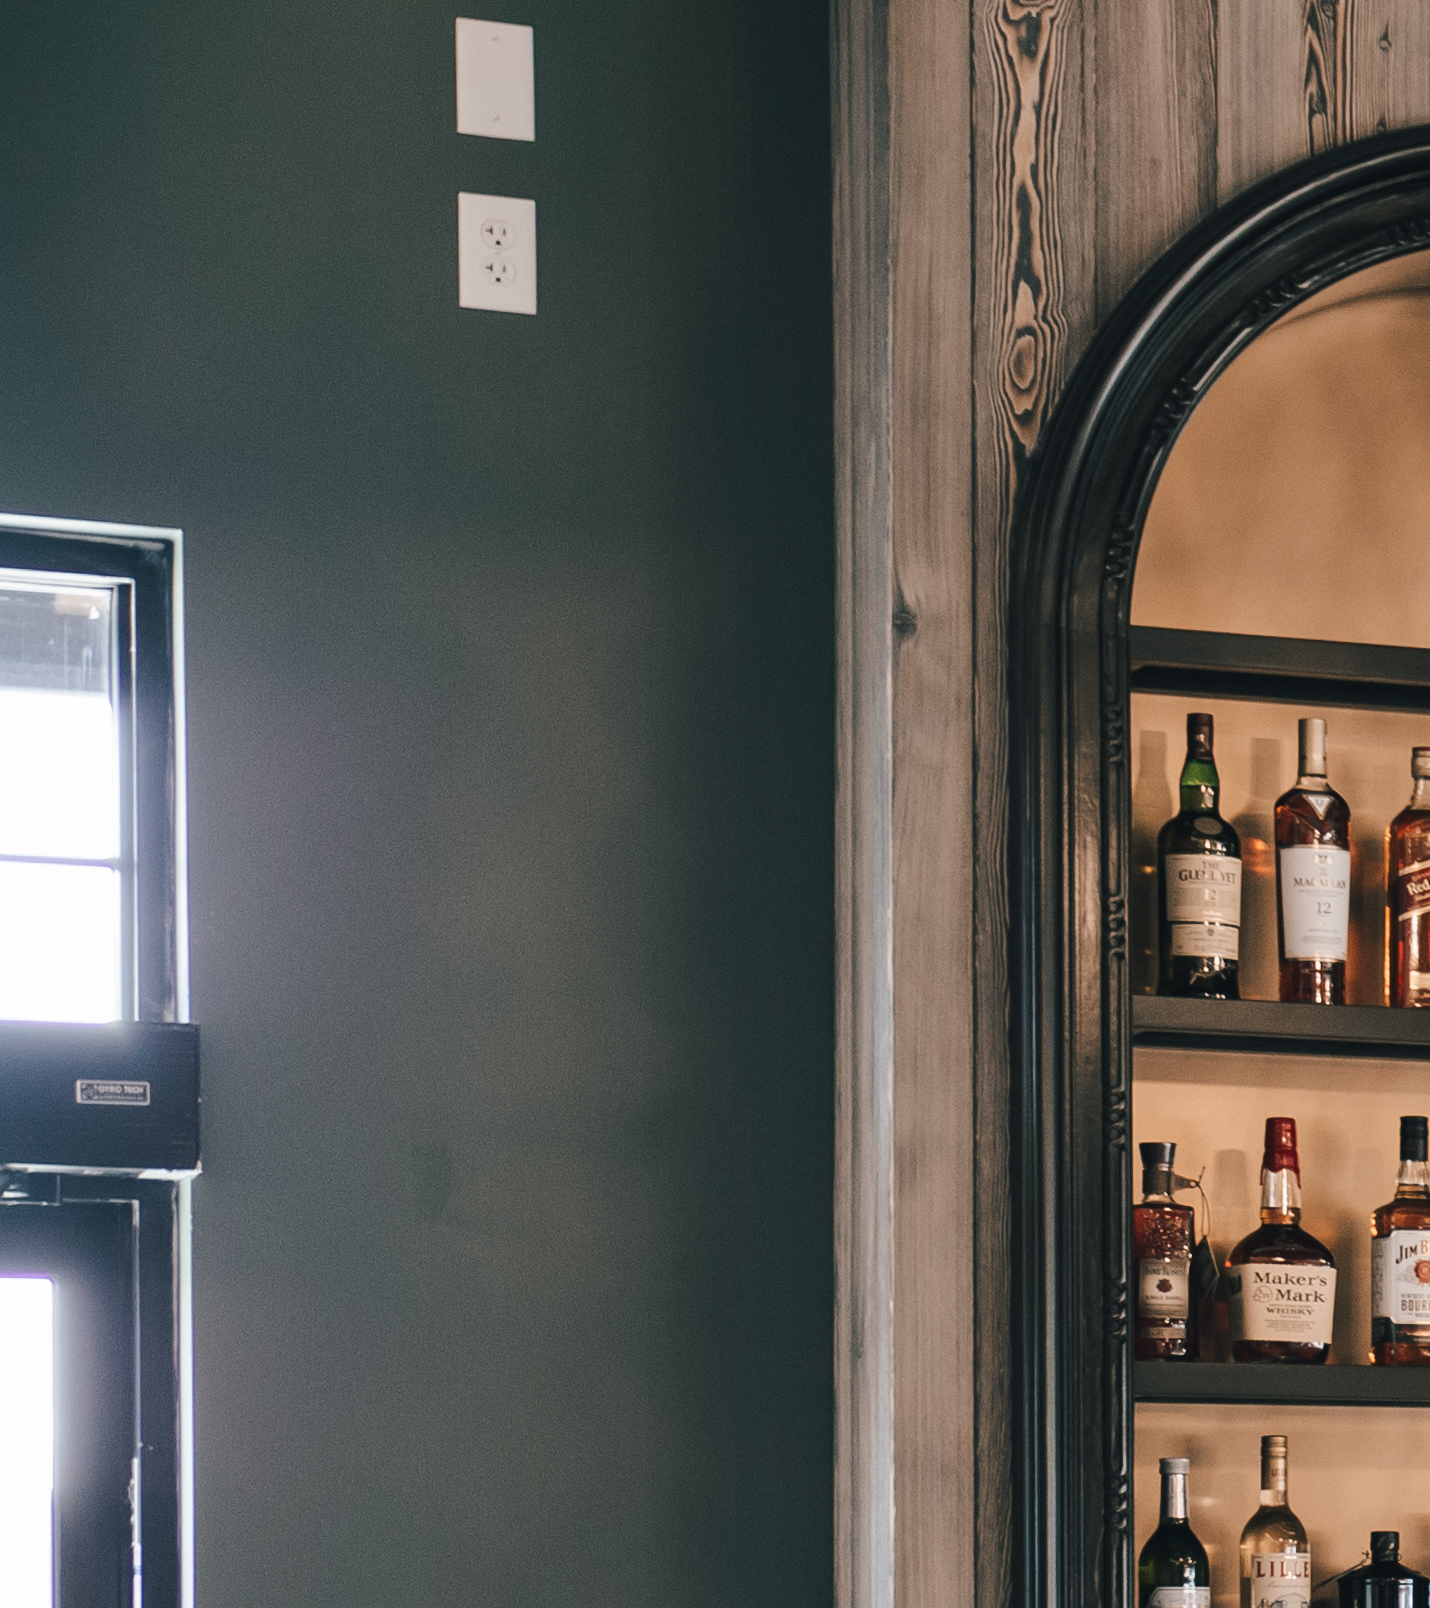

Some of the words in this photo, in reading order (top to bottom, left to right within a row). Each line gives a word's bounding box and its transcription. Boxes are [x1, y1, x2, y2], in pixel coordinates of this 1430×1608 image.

[1179, 869, 1236, 885] GLENLVET
[1406, 881, 1430, 897] Red
[1317, 901, 1332, 914] 12
[1396, 1244, 1418, 1265] JIM
[1253, 1271, 1328, 1287] Maker's
[1275, 1288, 1326, 1303] Mark
[1266, 1307, 1313, 1316] WHISKY
